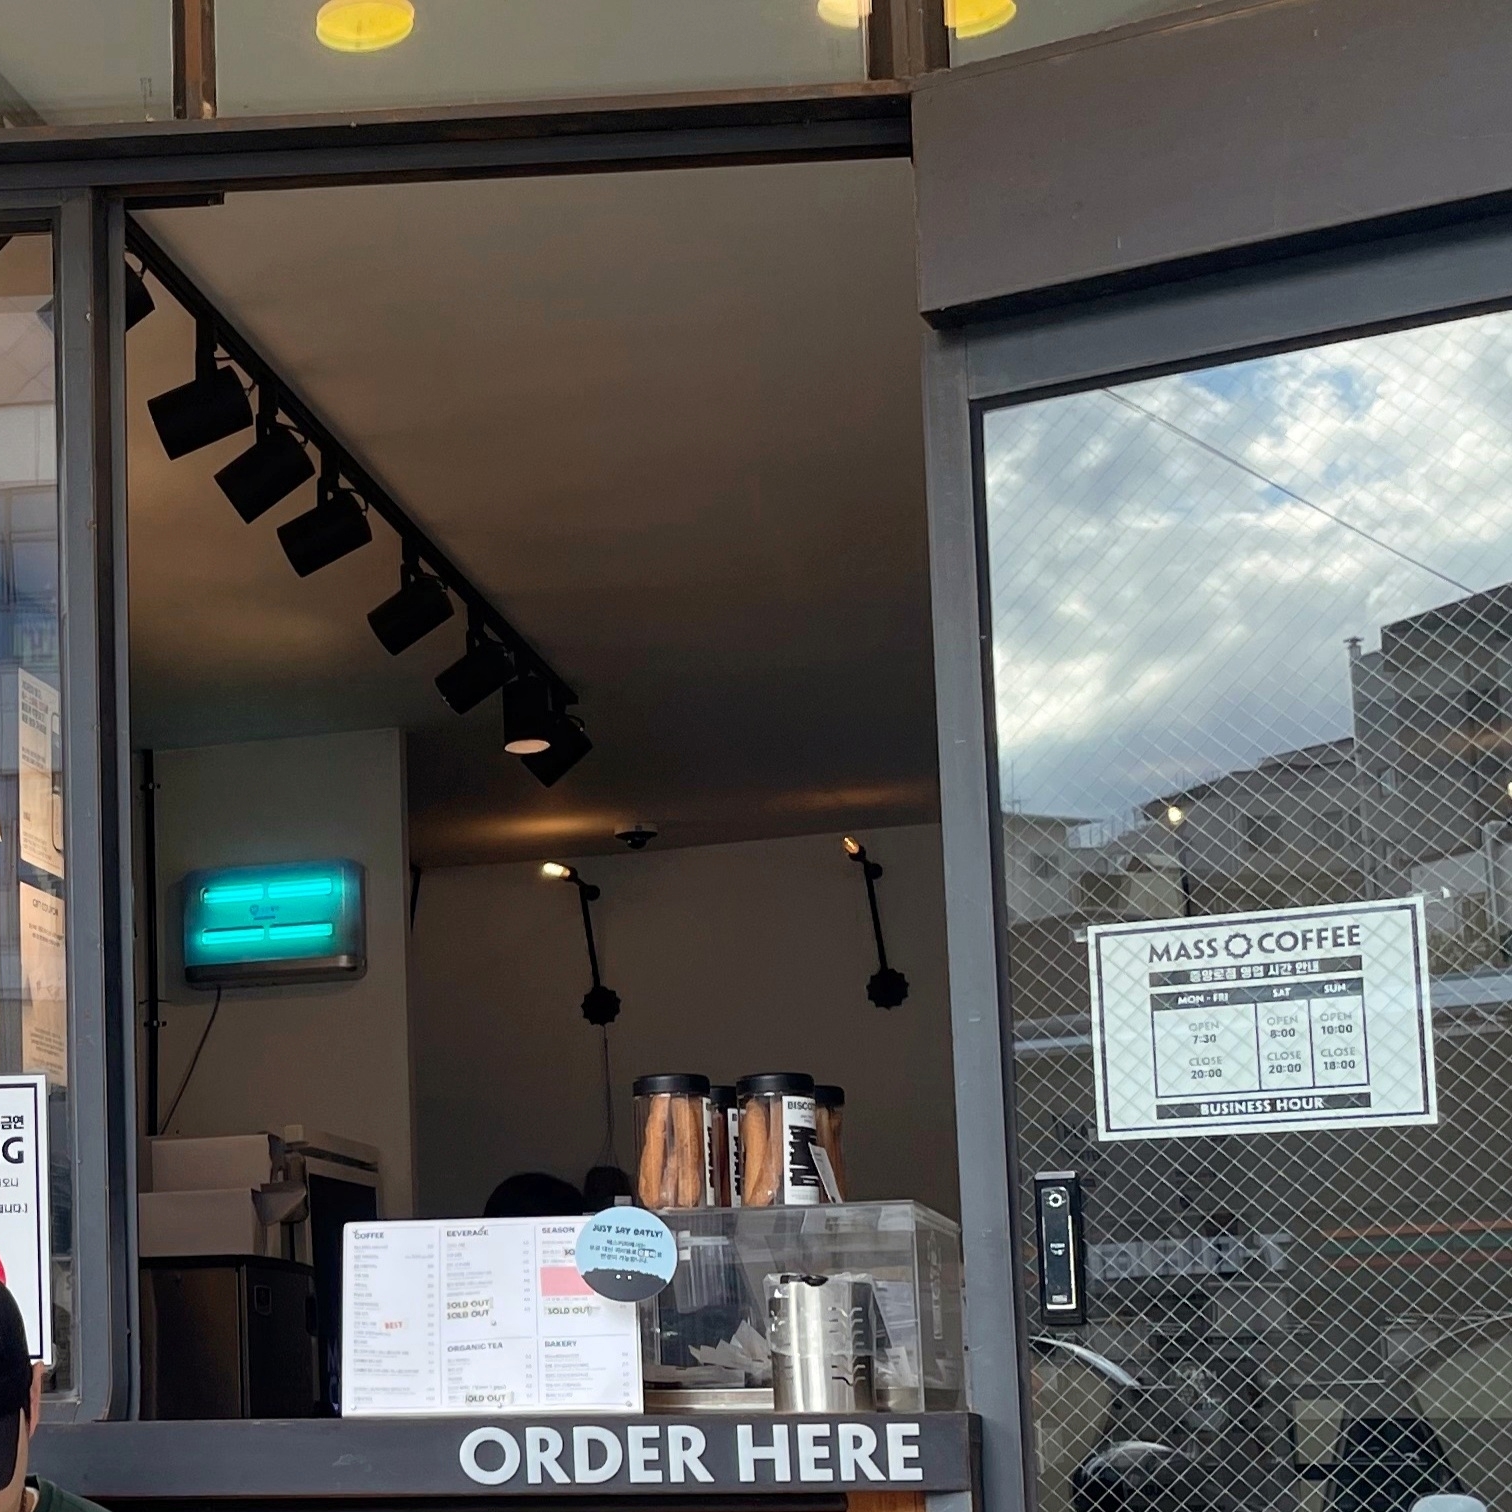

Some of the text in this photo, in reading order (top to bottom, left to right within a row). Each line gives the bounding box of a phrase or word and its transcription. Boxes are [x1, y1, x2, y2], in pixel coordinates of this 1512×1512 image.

[1149, 925, 1361, 963] MASS COFFEE
[1268, 962, 1292, 977] 시간
[1295, 961, 1319, 975] 안내
[1272, 988, 1292, 998] SAT
[1324, 983, 1346, 993] SUN
[1178, 995, 1204, 1005] MON
[1213, 993, 1229, 1002] FRI
[1266, 1015, 1298, 1026] OPEN
[1319, 1011, 1352, 1022] OPEN
[1188, 1021, 1220, 1032] OPEN
[1321, 1024, 1353, 1035] 10:00
[1270, 1028, 1295, 1038] 8:00
[1192, 1034, 1216, 1044] 7:30
[1266, 1050, 1301, 1062] CLOSE
[1320, 1047, 1356, 1058] CLOSE
[1188, 1056, 1223, 1067] CLOSE
[1323, 1060, 1355, 1071] 18:00
[1190, 1068, 1222, 1079] 20:00
[1268, 1063, 1301, 1074] 20:00
[1200, 1097, 1325, 1116] BUSINESS HOUR
[1, 1115, 25, 1130] 금연
[593, 1224, 612, 1233] JUST
[615, 1226, 631, 1234] SAY
[354, 1232, 384, 1240] COFFEE
[447, 1299, 490, 1310] SOLD OUT
[471, 1310, 489, 1318] OUT
[547, 1307, 569, 1315] SOLD
[385, 1321, 403, 1330] BEST
[447, 1342, 503, 1353] ORGANIC TEA
[459, 1422, 923, 1486] ORDER HERE
